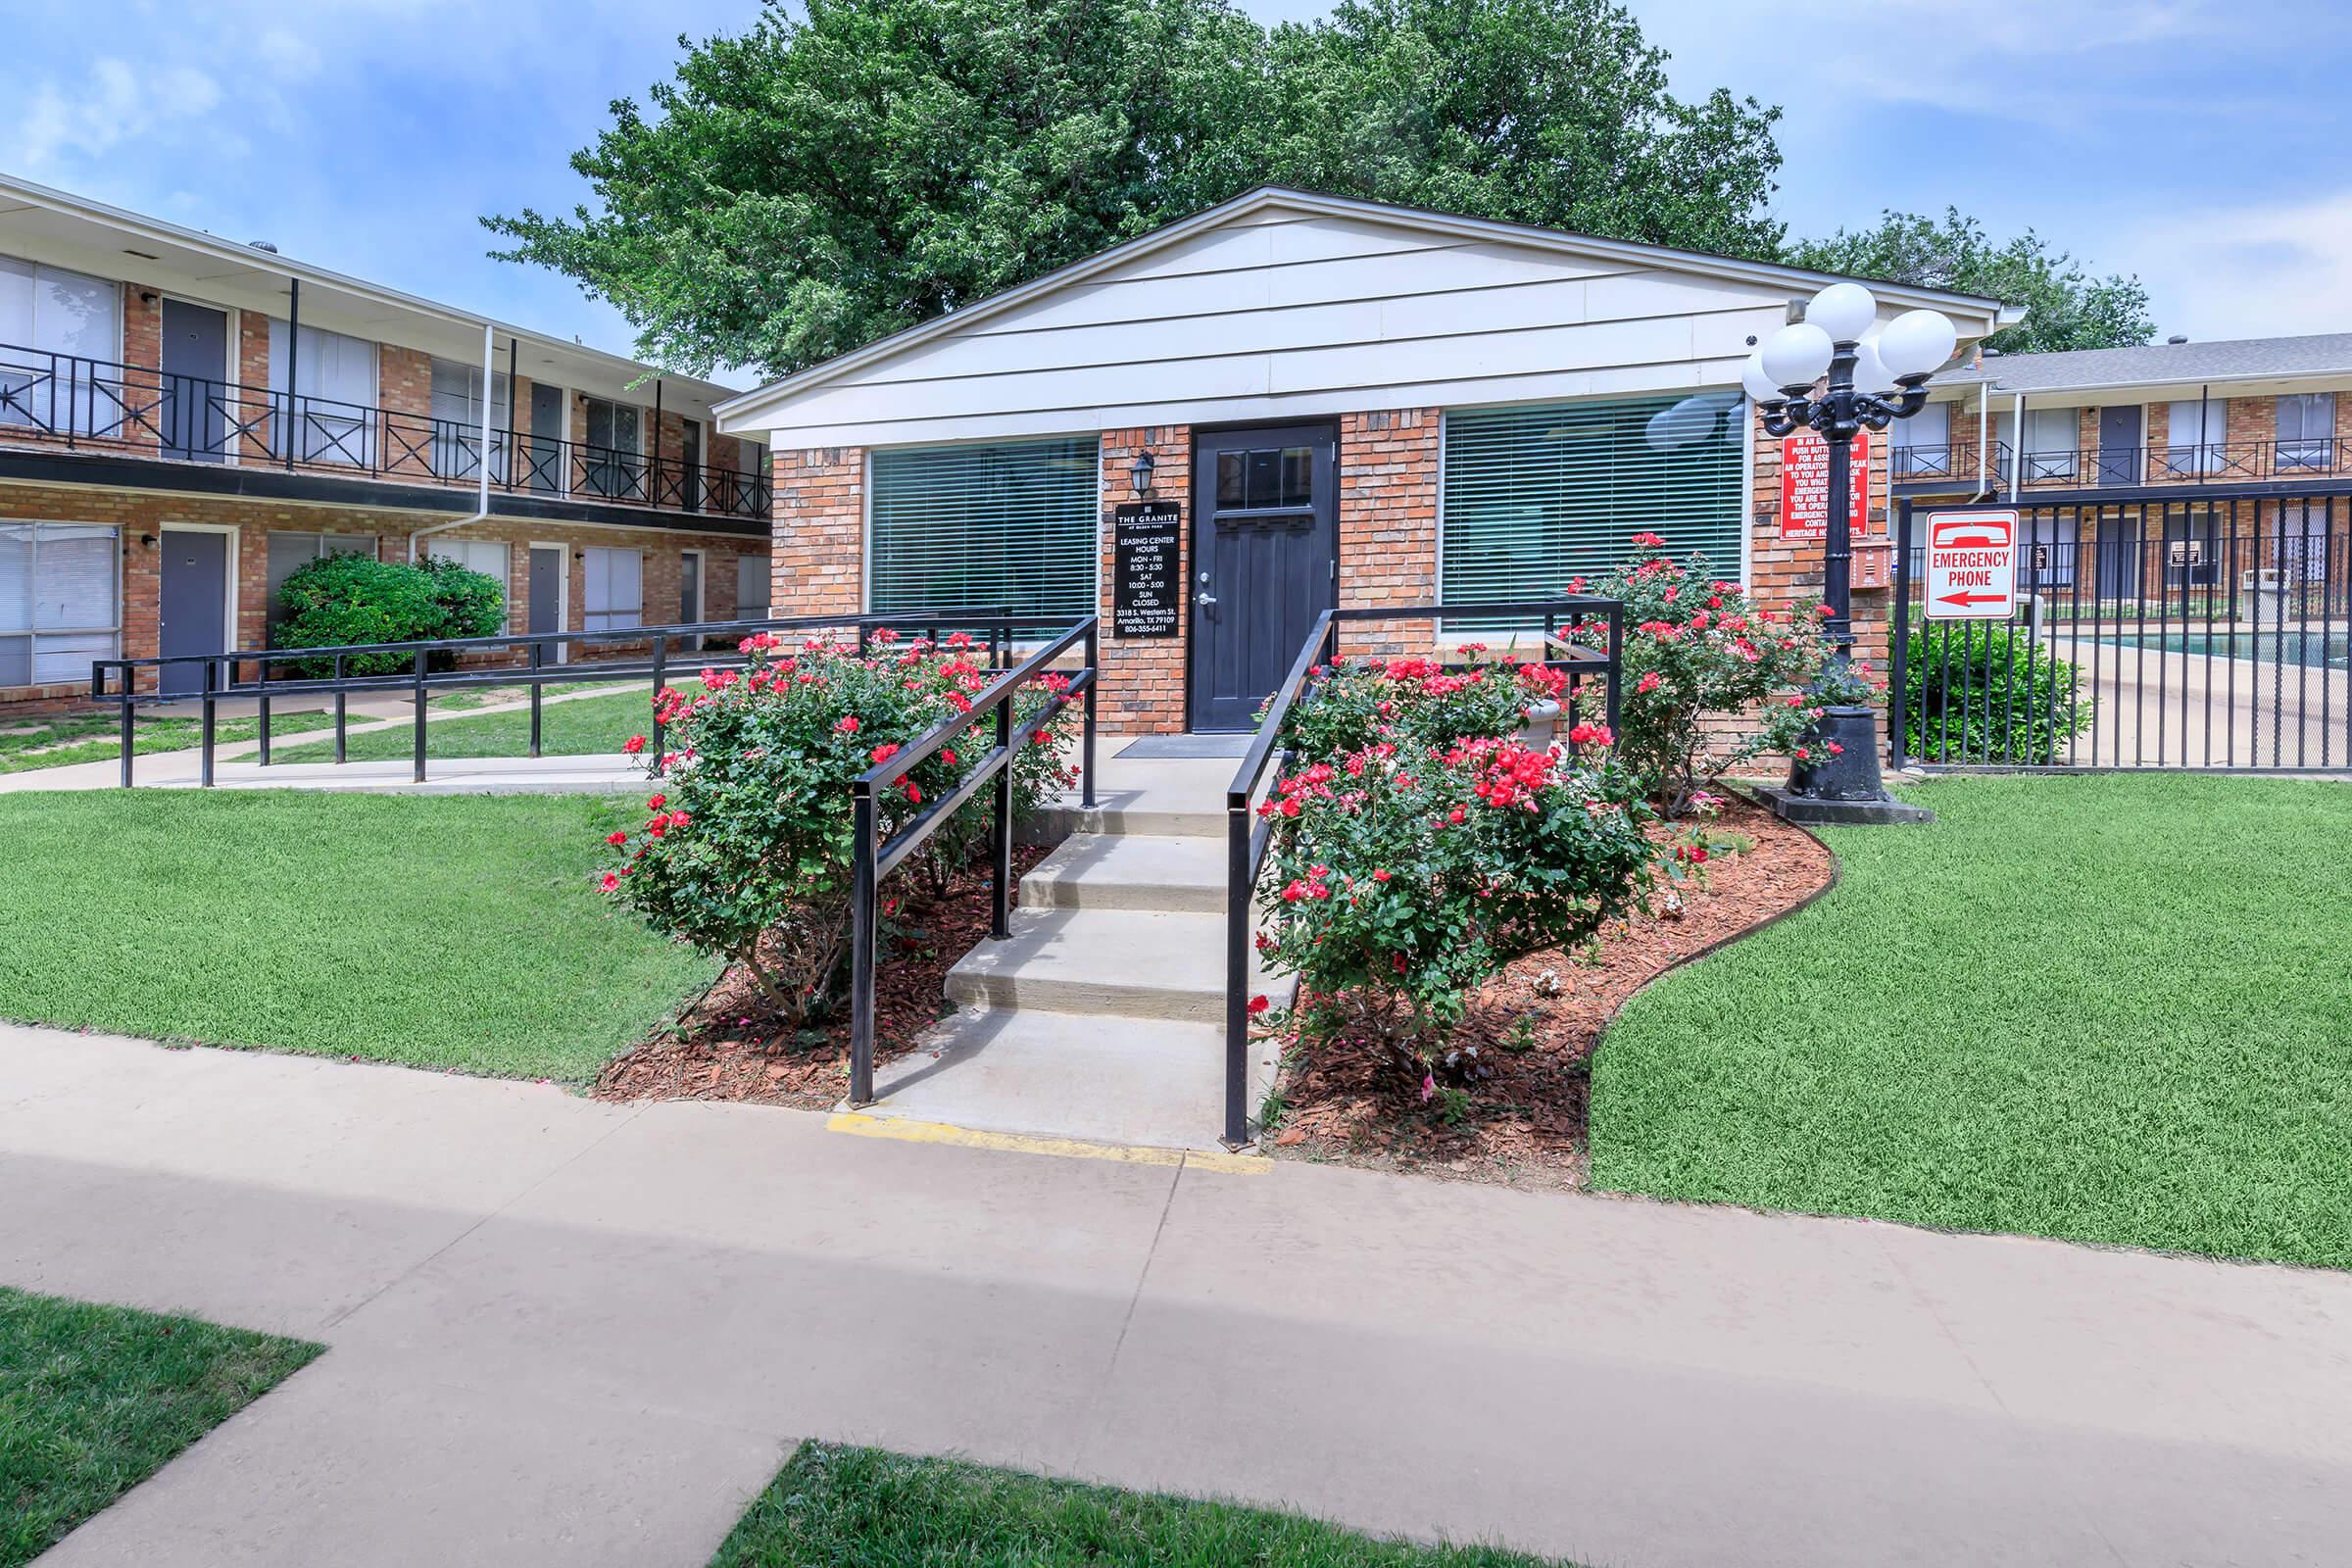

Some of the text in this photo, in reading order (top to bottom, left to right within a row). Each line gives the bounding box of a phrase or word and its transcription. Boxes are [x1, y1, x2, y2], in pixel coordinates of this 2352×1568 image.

[1794, 462, 1828, 470] OPERATOR
[1120, 536, 1175, 546] LEASING CENTER
[1136, 545, 1159, 554] HOURS
[1933, 551, 2009, 568] EMERGENCY
[1948, 570, 1992, 587] PHONE
[1117, 616, 1146, 625] Amarillo,
